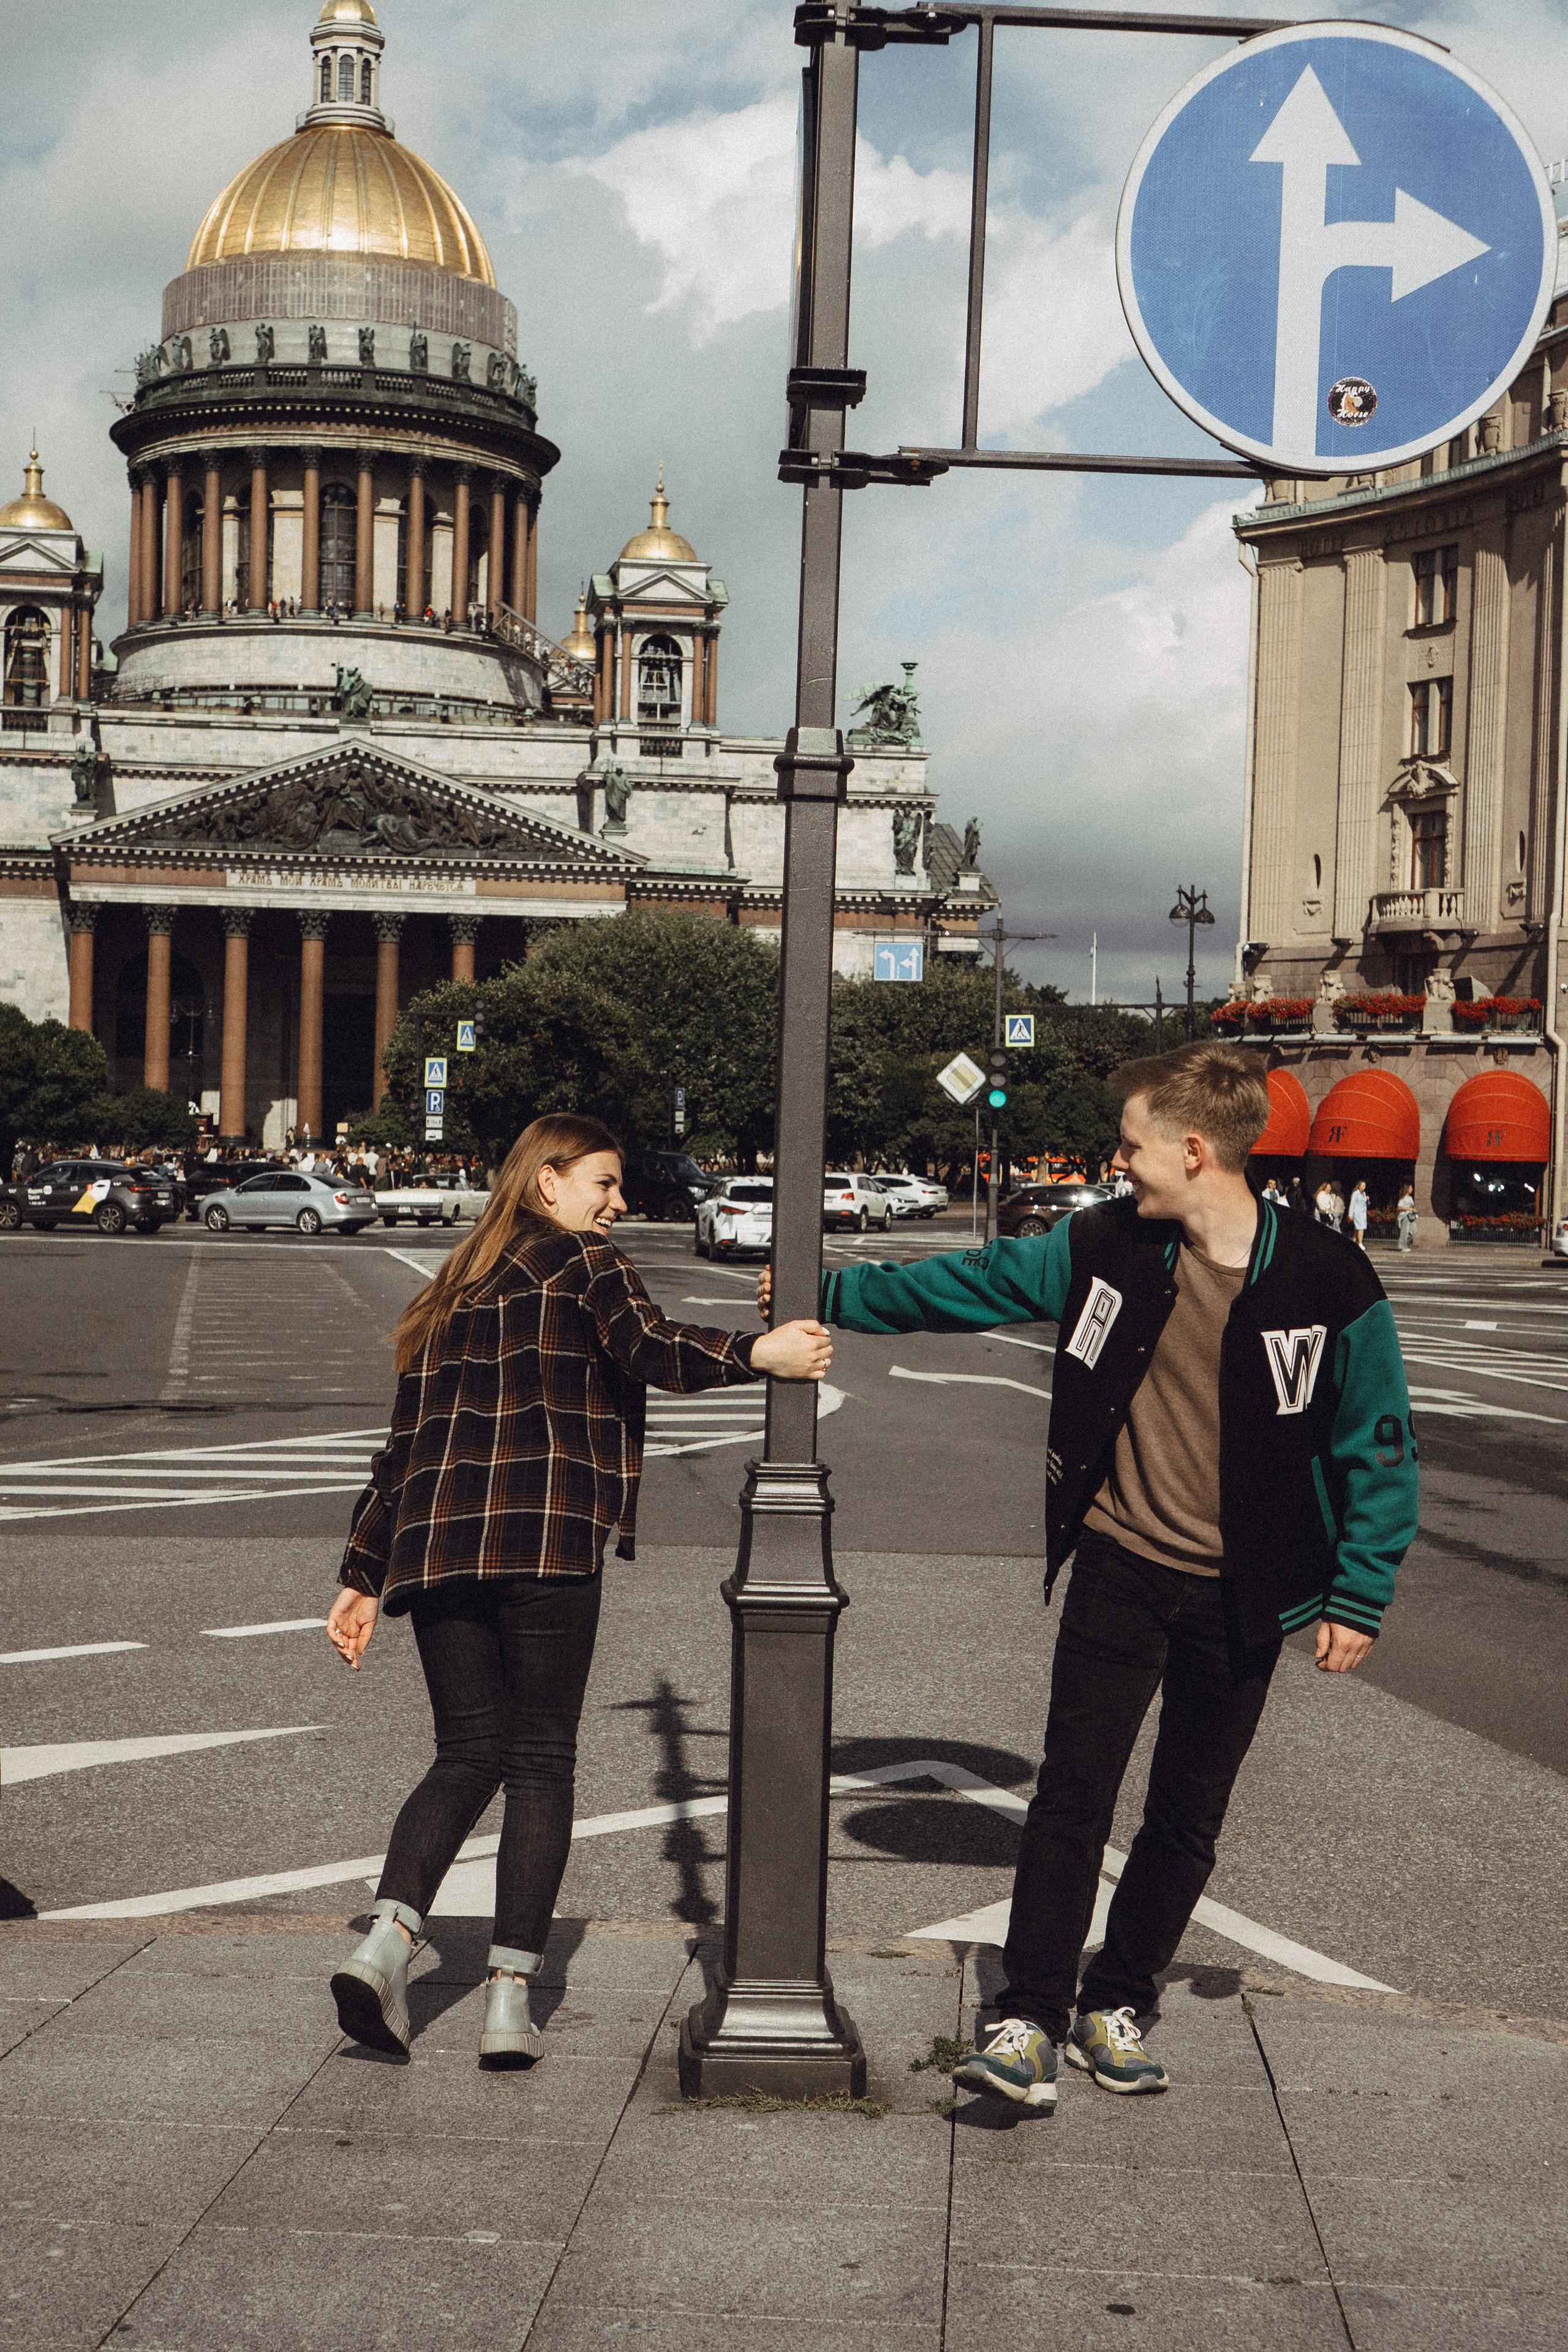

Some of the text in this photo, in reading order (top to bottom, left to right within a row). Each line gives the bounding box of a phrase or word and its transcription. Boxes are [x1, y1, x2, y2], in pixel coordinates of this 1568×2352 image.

[1335, 384, 1370, 393] Happy
[1336, 409, 1369, 418] Horse
[431, 1093, 440, 1111] P
[1065, 1276, 1123, 1371] R
[1260, 1324, 1327, 1415] W
